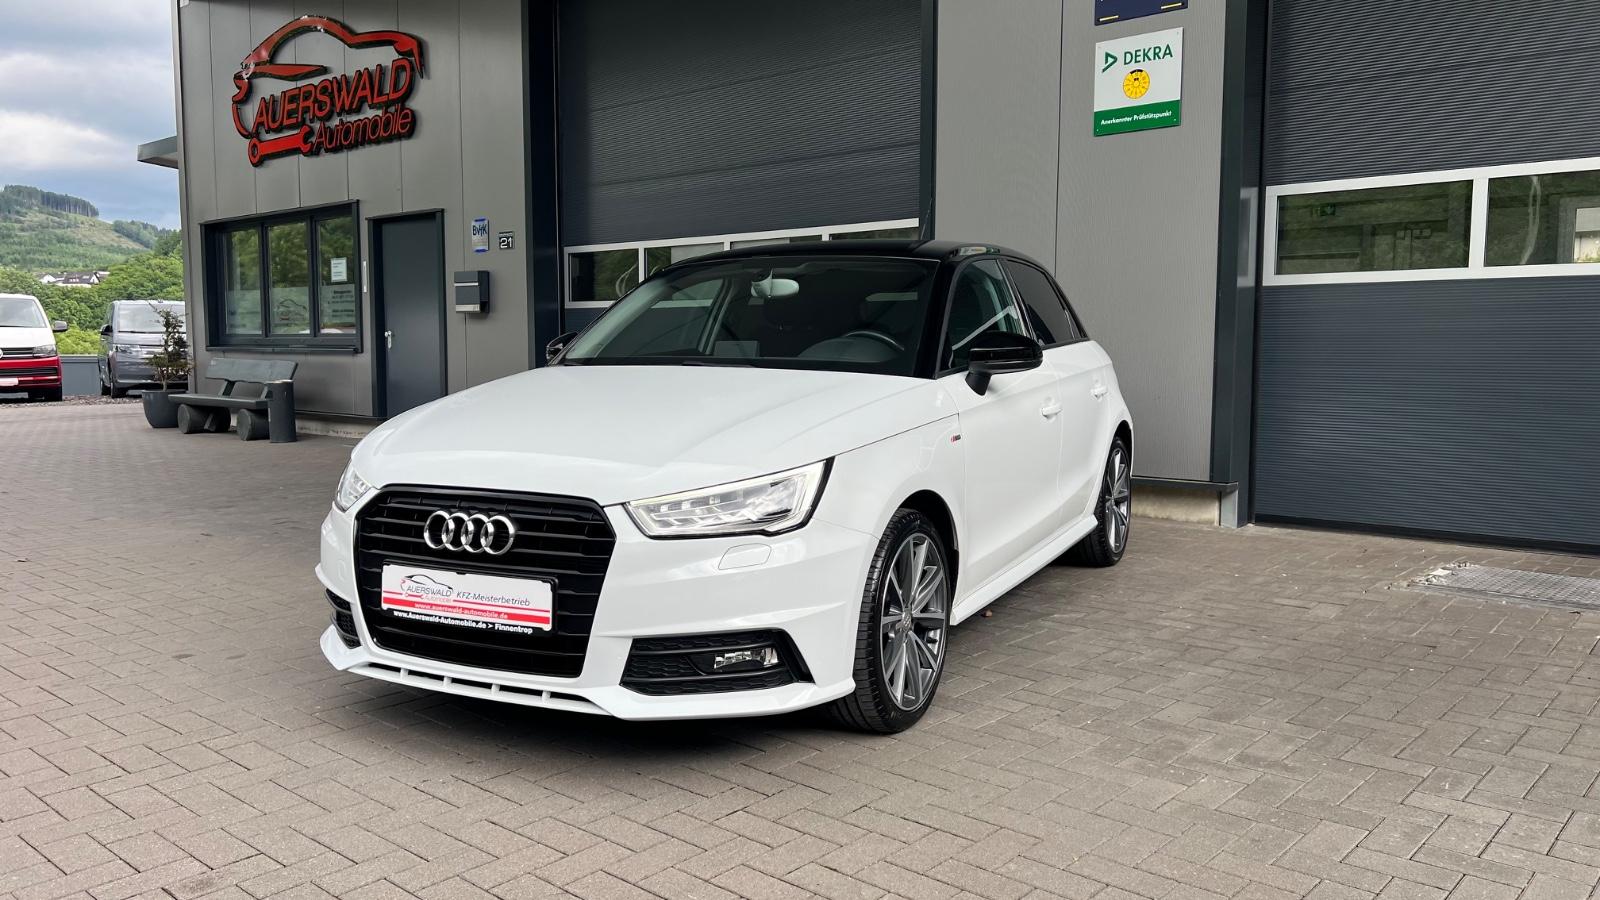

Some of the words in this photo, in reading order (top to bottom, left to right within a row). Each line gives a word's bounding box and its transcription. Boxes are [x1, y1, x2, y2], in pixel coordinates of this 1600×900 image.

[1123, 43, 1173, 66] DEKRA
[252, 57, 413, 135] AUERSWALD
[312, 106, 413, 152] Automobile
[1100, 116, 1132, 126] Anerkannter
[1133, 110, 1172, 121] Prüfstützpunkt
[500, 237, 512, 249] 21
[406, 585, 452, 597] AUERSWALD
[456, 591, 531, 607] KFZ-Meisterbetrieb
[414, 602, 508, 619] www.auerswald-automobile.de
[393, 610, 487, 629] www.Auerswald-Automobile.de
[494, 623, 533, 635] Finnentrop
